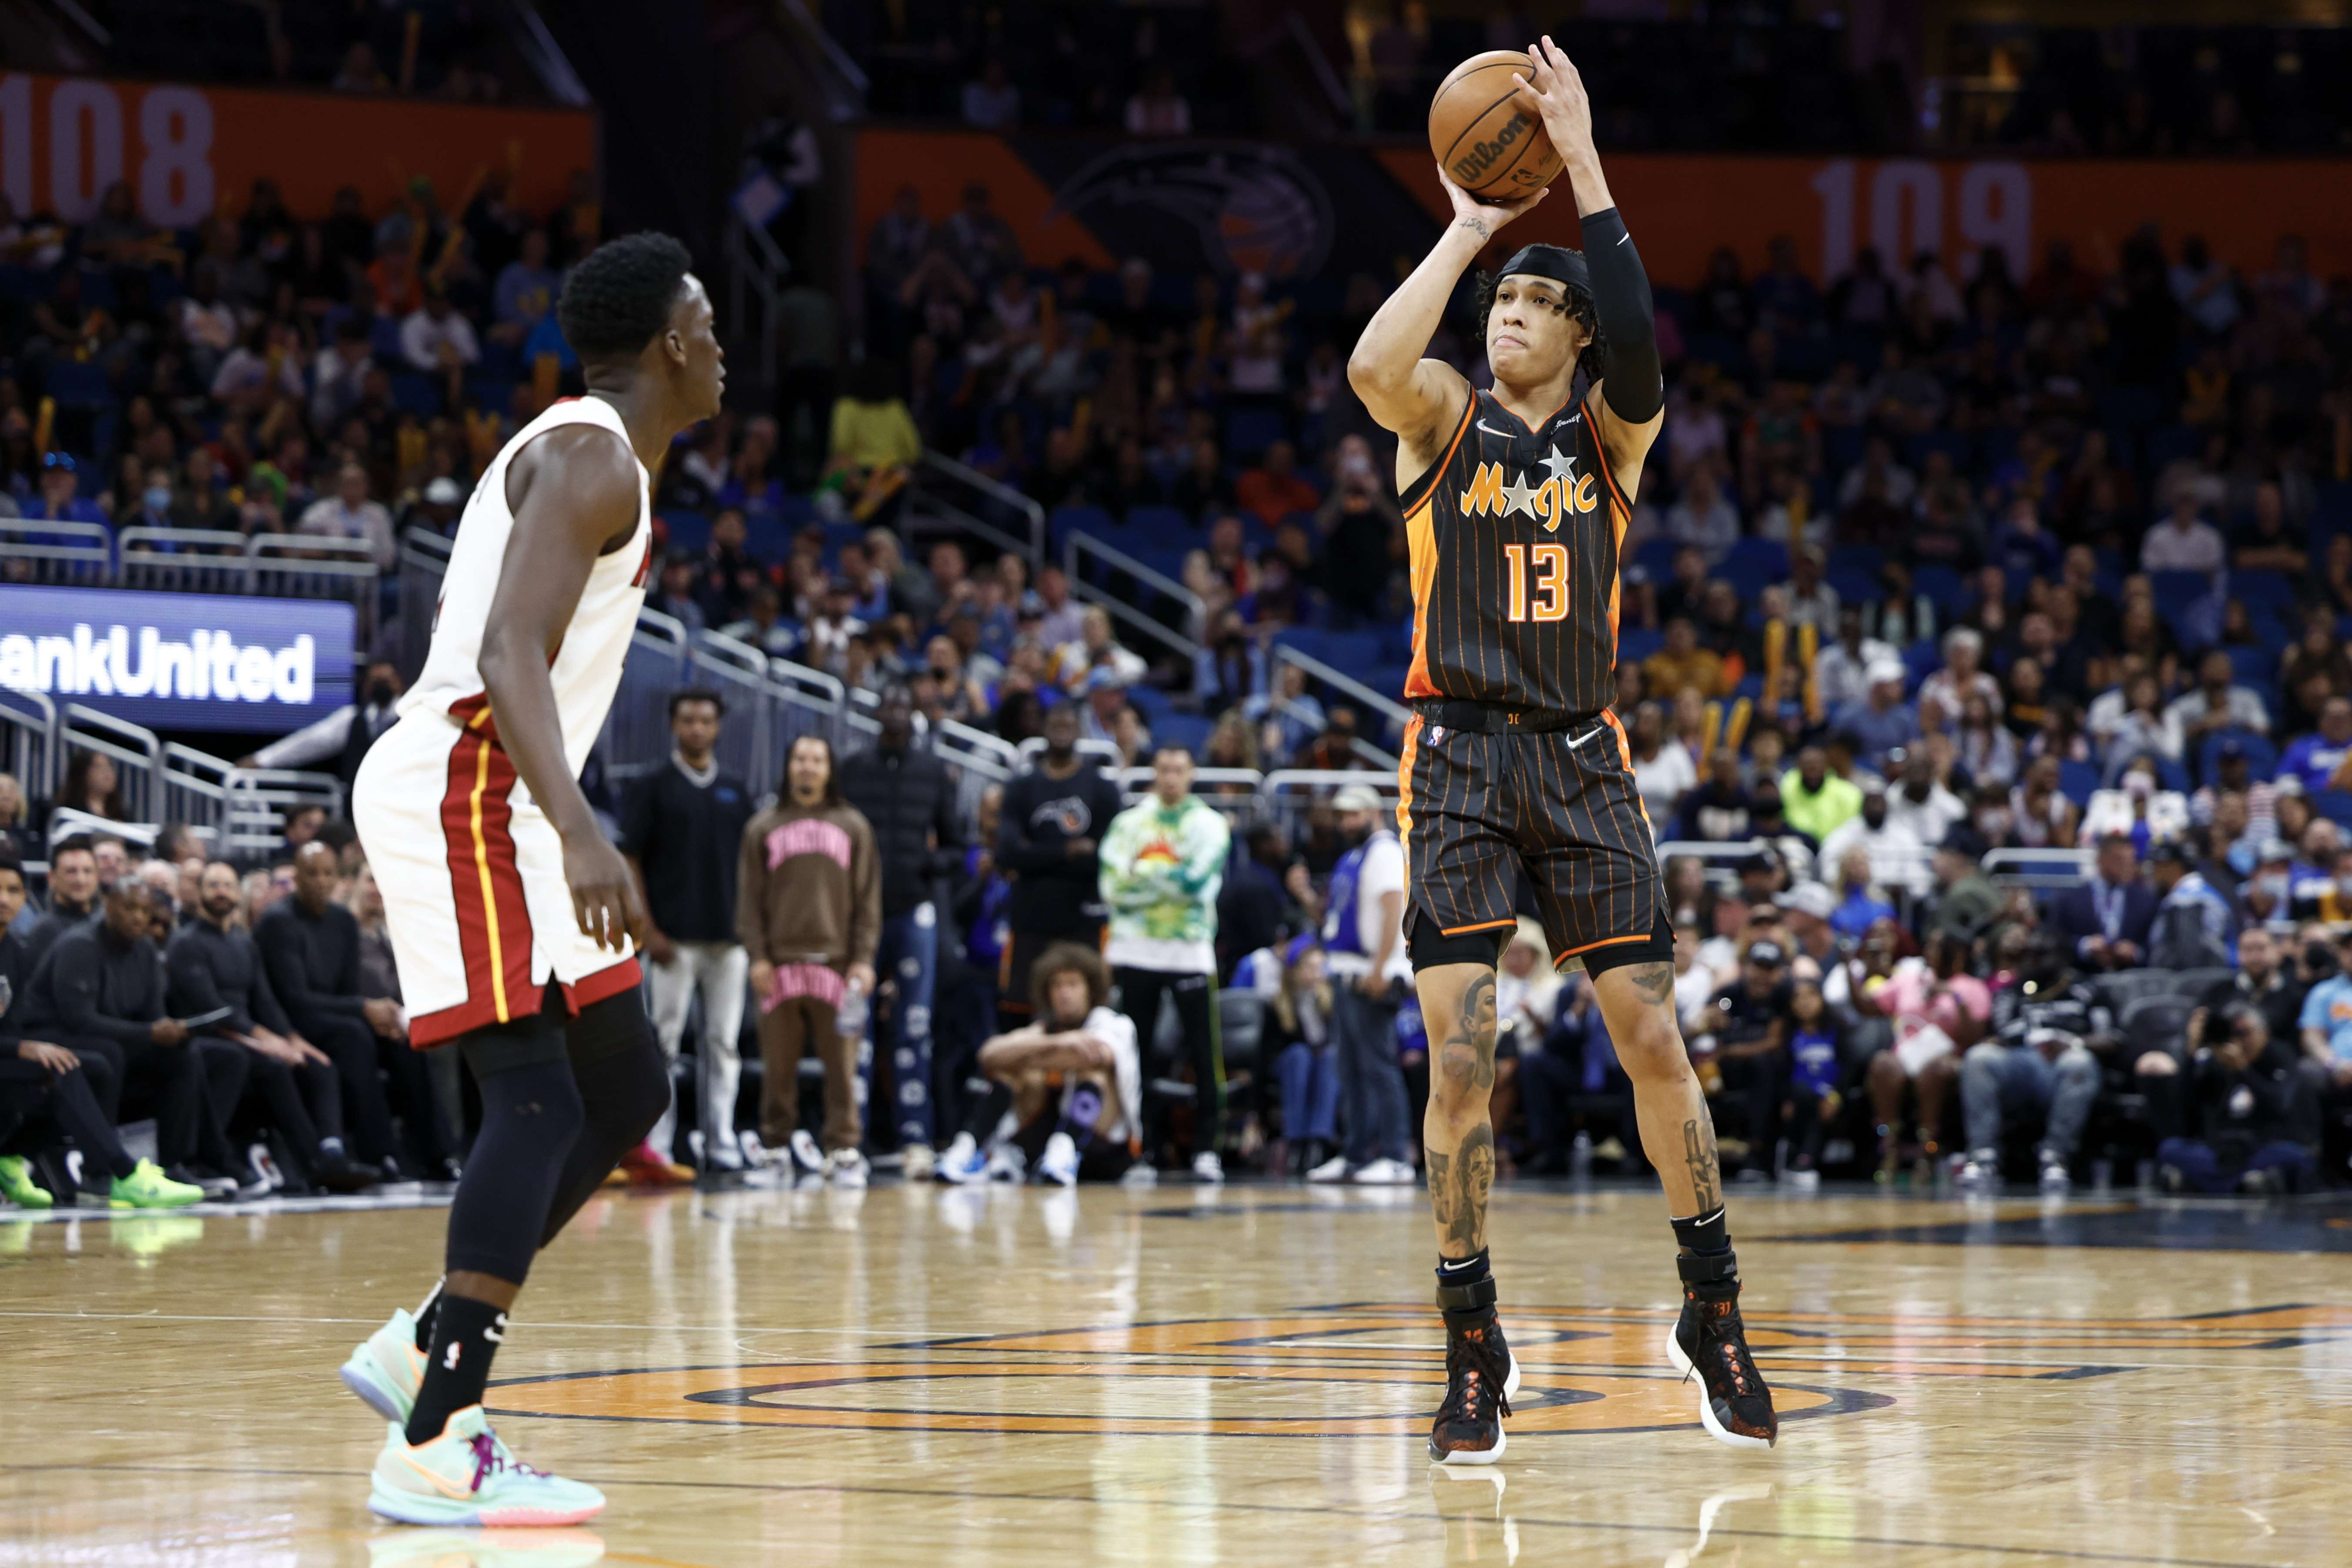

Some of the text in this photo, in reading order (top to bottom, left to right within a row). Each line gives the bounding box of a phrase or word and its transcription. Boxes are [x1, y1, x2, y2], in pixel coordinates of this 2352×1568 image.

[0, 72, 215, 228] 108
[1452, 112, 1532, 183] Wilson
[1810, 156, 2032, 296] 109
[1550, 412, 1581, 435] Disney
[1504, 543, 1570, 623] 13
